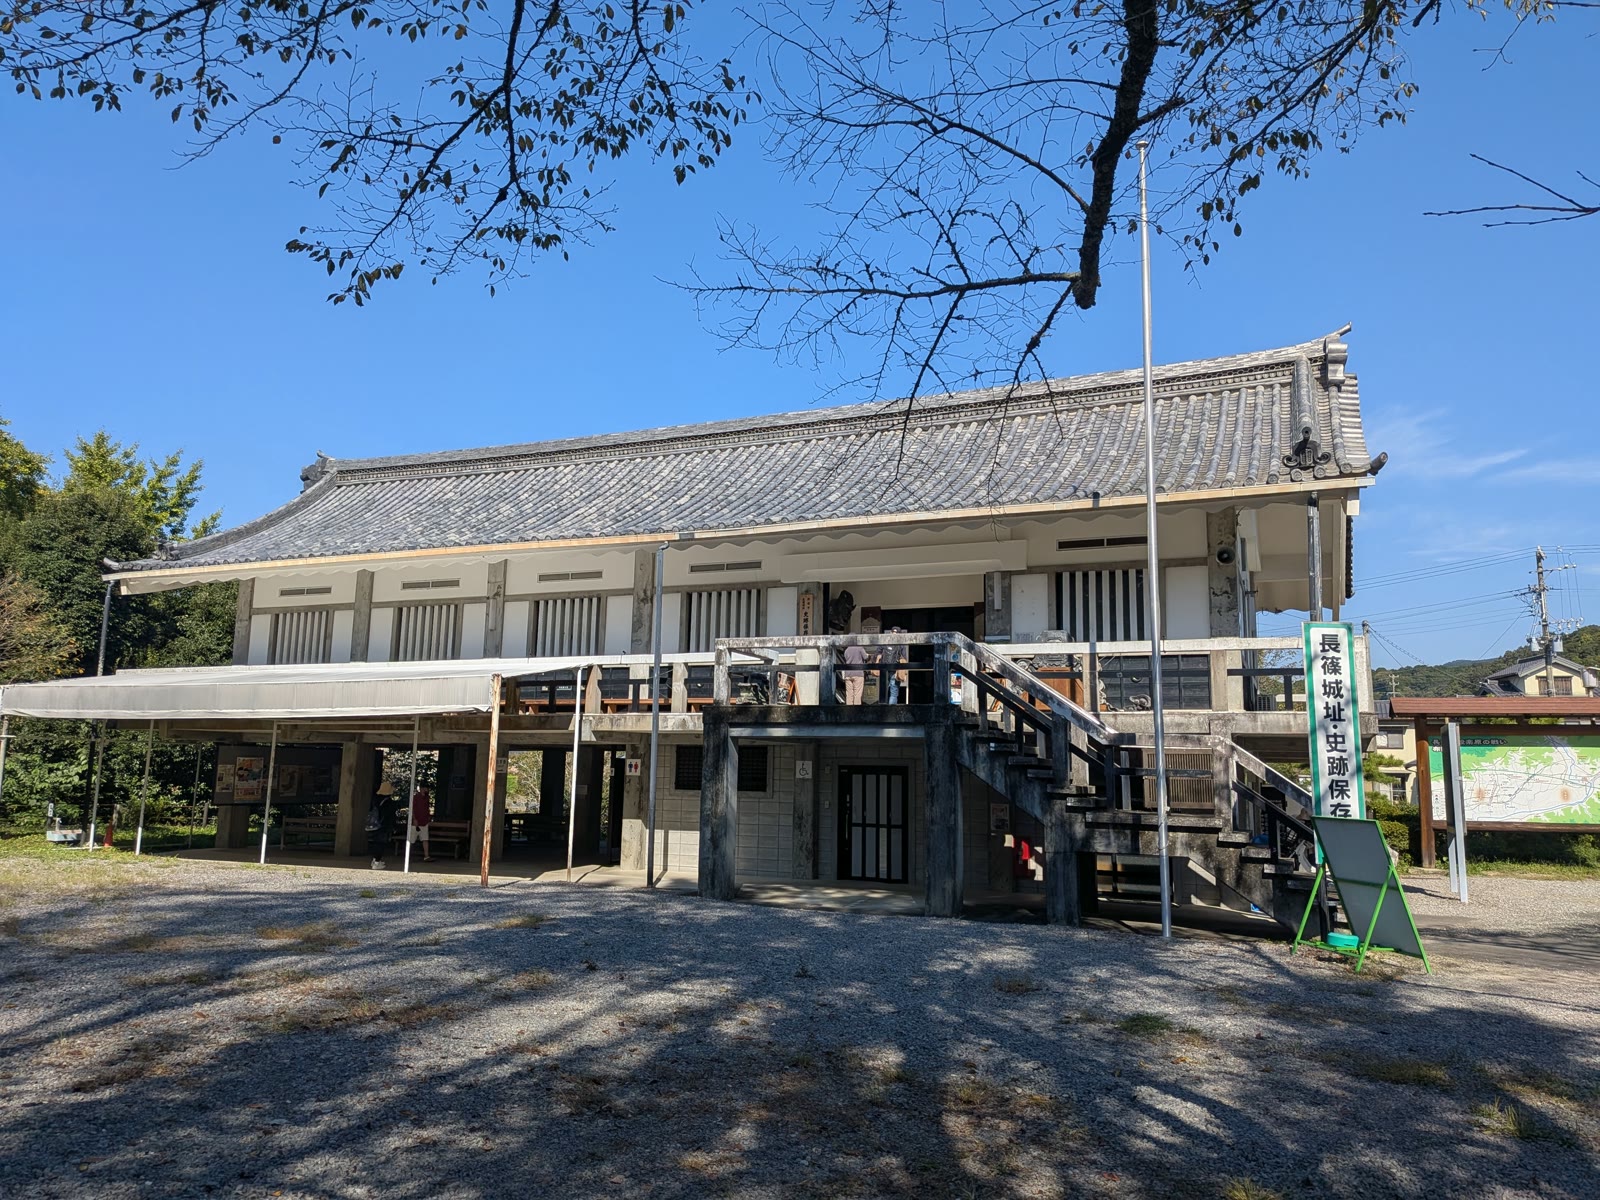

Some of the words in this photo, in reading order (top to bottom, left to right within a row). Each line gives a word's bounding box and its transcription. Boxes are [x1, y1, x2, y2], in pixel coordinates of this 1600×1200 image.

[1319, 633, 1352, 818] 長篠城址・史跡保存
